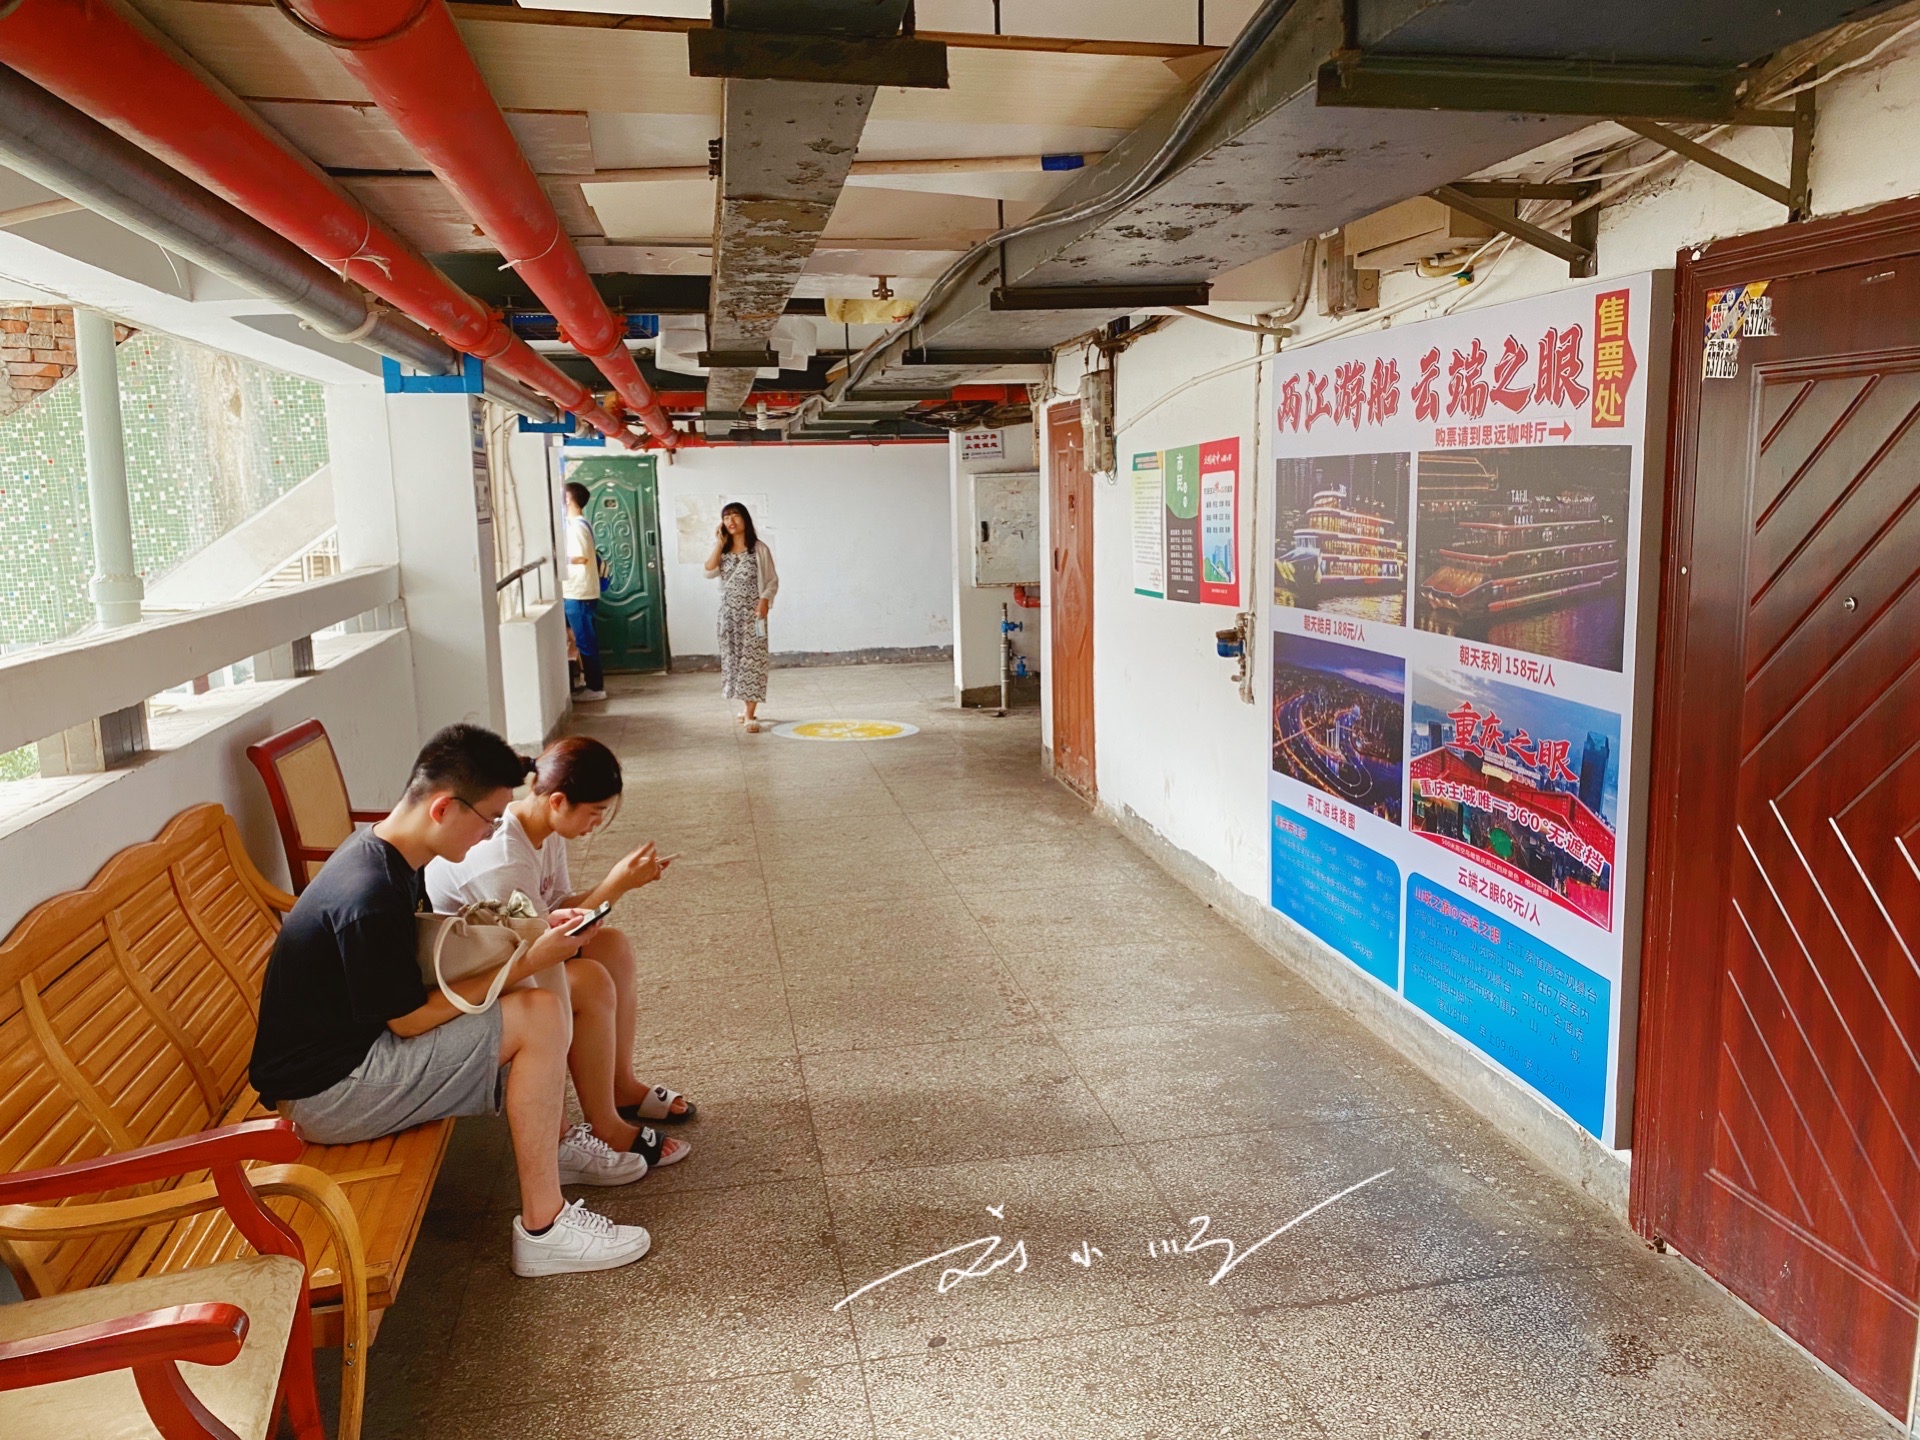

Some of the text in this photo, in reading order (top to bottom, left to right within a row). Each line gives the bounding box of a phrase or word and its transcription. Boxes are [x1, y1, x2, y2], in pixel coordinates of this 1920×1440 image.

[1277, 322, 1591, 433] 两江游船 云端之眼
[1594, 296, 1625, 423] 售票处
[1435, 422, 1547, 447] 购票请到思远咖啡厅
[1333, 620, 1365, 641] 188元/人
[1459, 645, 1555, 687] 朝天系列 158元/人
[1445, 702, 1579, 782] 重庆之眼
[1307, 794, 1356, 831] 两江游线路图
[1420, 778, 1606, 875] 重庆主城唯一360°无遮挡
[1458, 866, 1541, 926] 云端之眼68元/人
[1536, 976, 1590, 1025] 在67层室内
